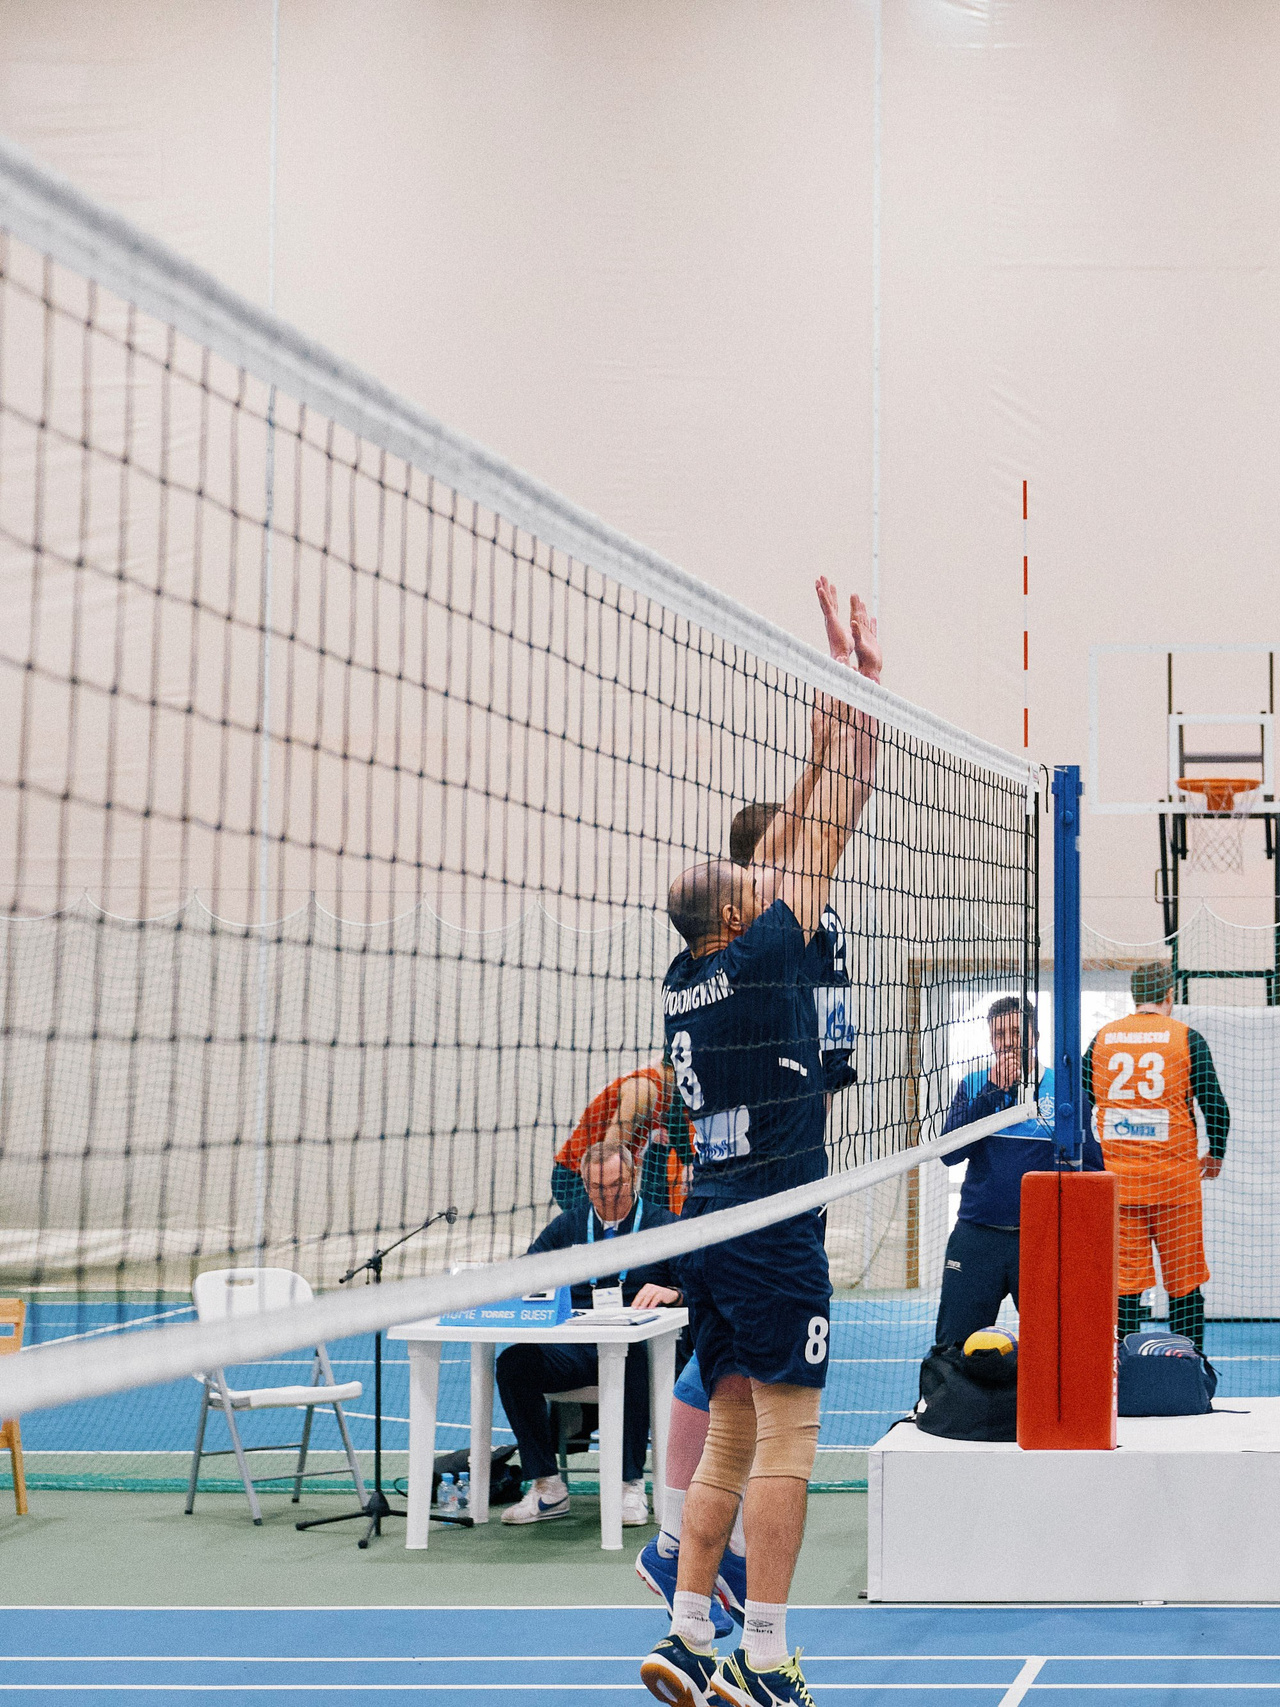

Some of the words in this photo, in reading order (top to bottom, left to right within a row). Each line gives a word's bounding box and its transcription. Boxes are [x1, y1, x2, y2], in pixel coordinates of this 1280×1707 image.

[670, 1030, 705, 1111] 8
[1107, 1051, 1166, 1101] 23
[480, 1310, 516, 1319] TORRES
[520, 1309, 555, 1321] GUEST
[804, 1315, 829, 1365] 8
